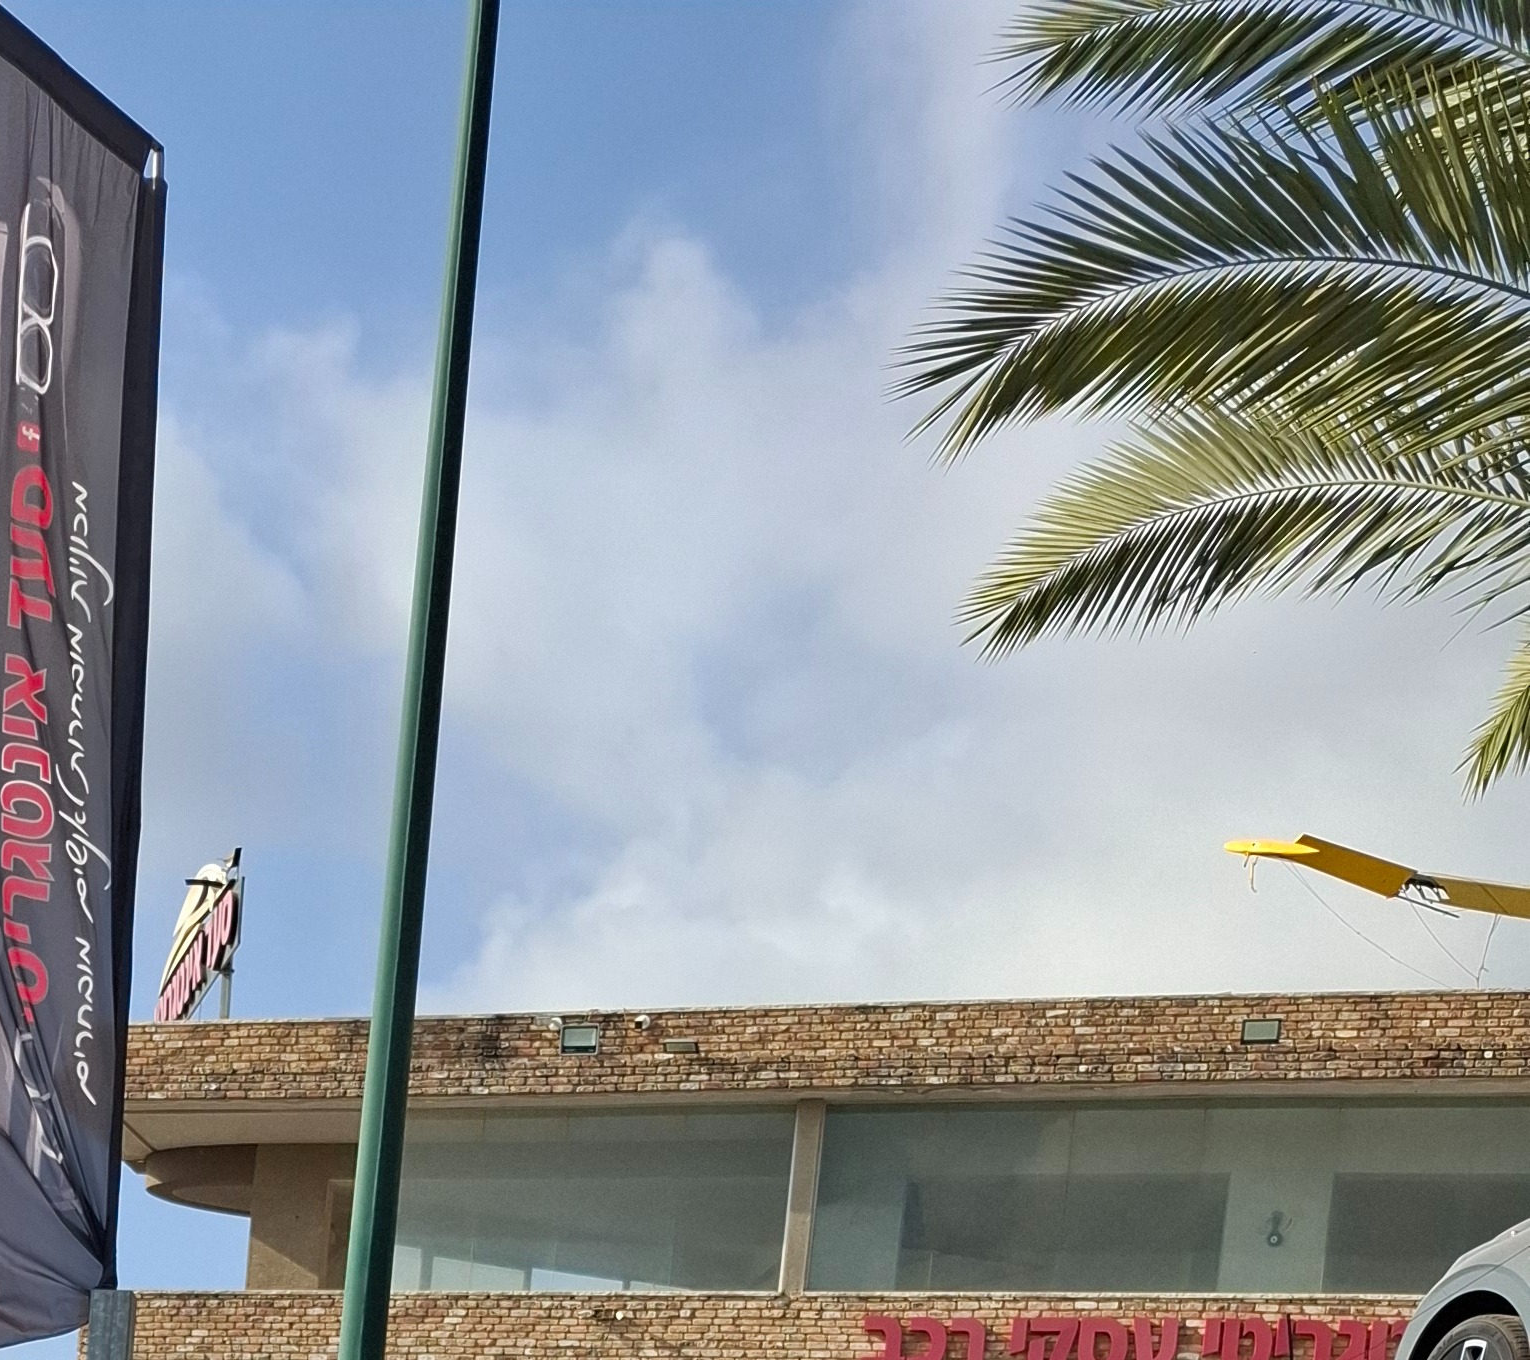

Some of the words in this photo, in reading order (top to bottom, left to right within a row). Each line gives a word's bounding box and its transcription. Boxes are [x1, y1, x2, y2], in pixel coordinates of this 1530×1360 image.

[8, 465, 56, 629] סעד
[69, 480, 114, 622] מכוניות
[66, 623, 90, 793] מובחרות
[54, 763, 112, 923] לאנשים
[73, 936, 98, 1105] מובחרים
